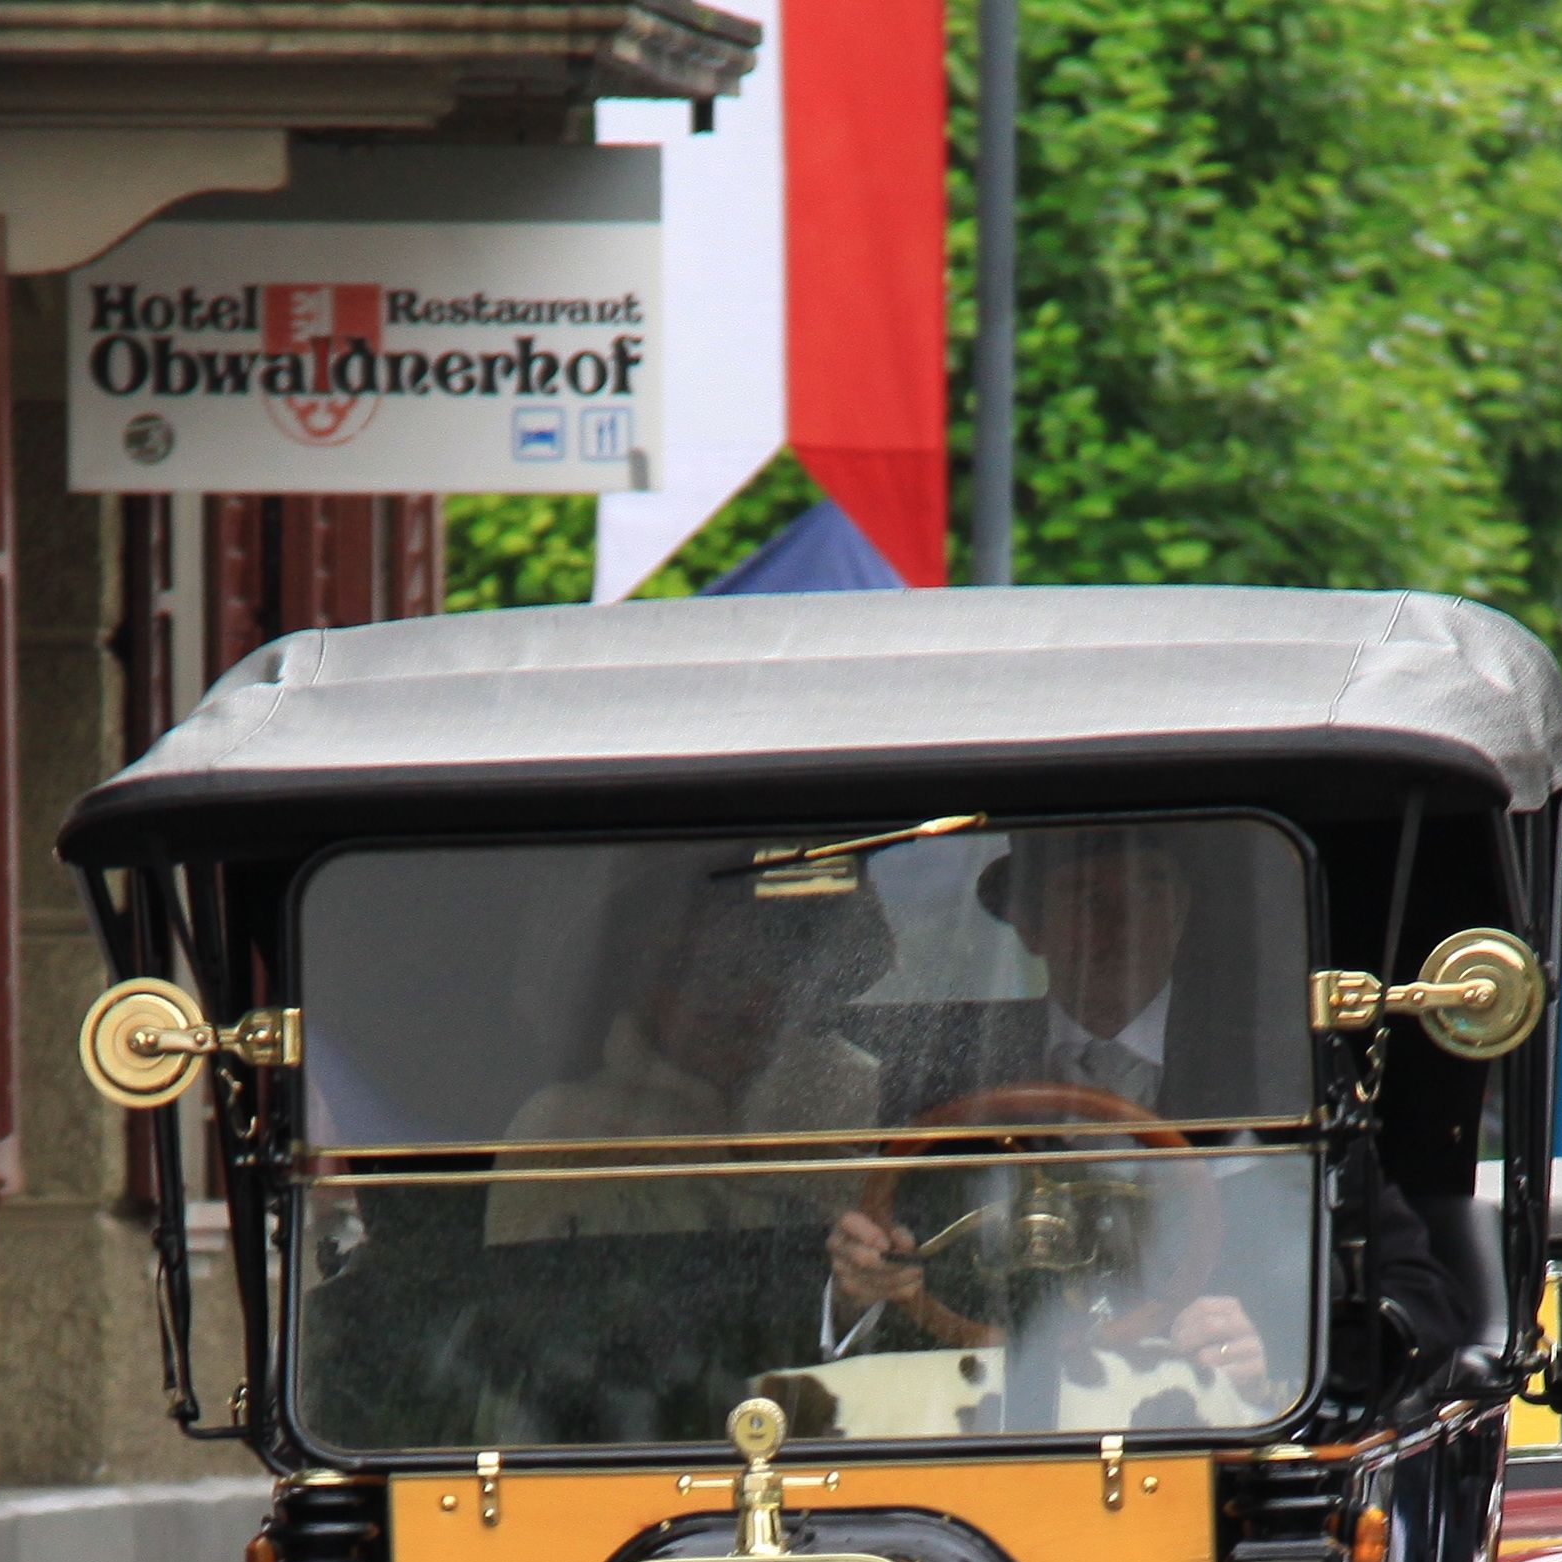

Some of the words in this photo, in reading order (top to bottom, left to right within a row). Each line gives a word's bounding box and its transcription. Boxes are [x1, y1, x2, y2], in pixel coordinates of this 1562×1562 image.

[90, 284, 262, 332] Hotel
[386, 290, 644, 327] Restaurant
[90, 335, 644, 396] Obwaldnerhof
